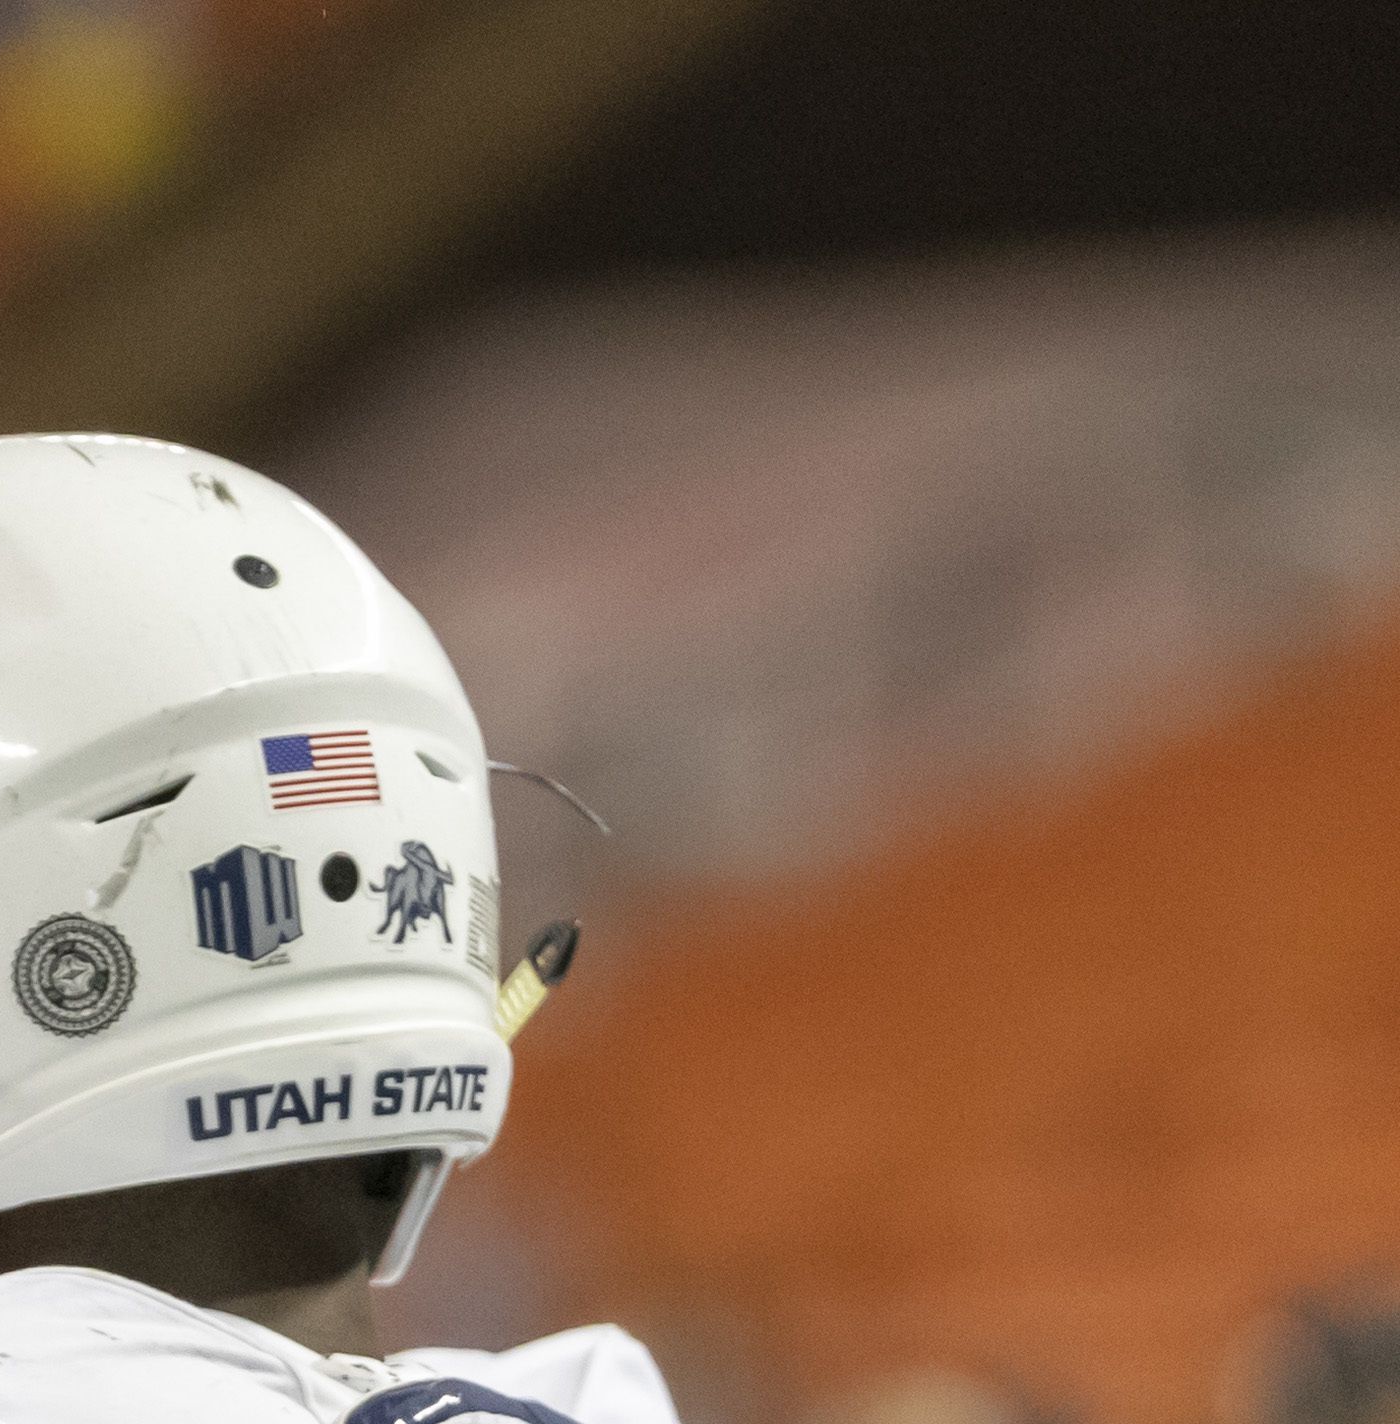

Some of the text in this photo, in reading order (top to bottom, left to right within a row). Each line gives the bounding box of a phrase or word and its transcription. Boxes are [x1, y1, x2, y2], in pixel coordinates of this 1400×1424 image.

[189, 844, 305, 962] MW
[185, 1064, 489, 1142] UTAH STATE
